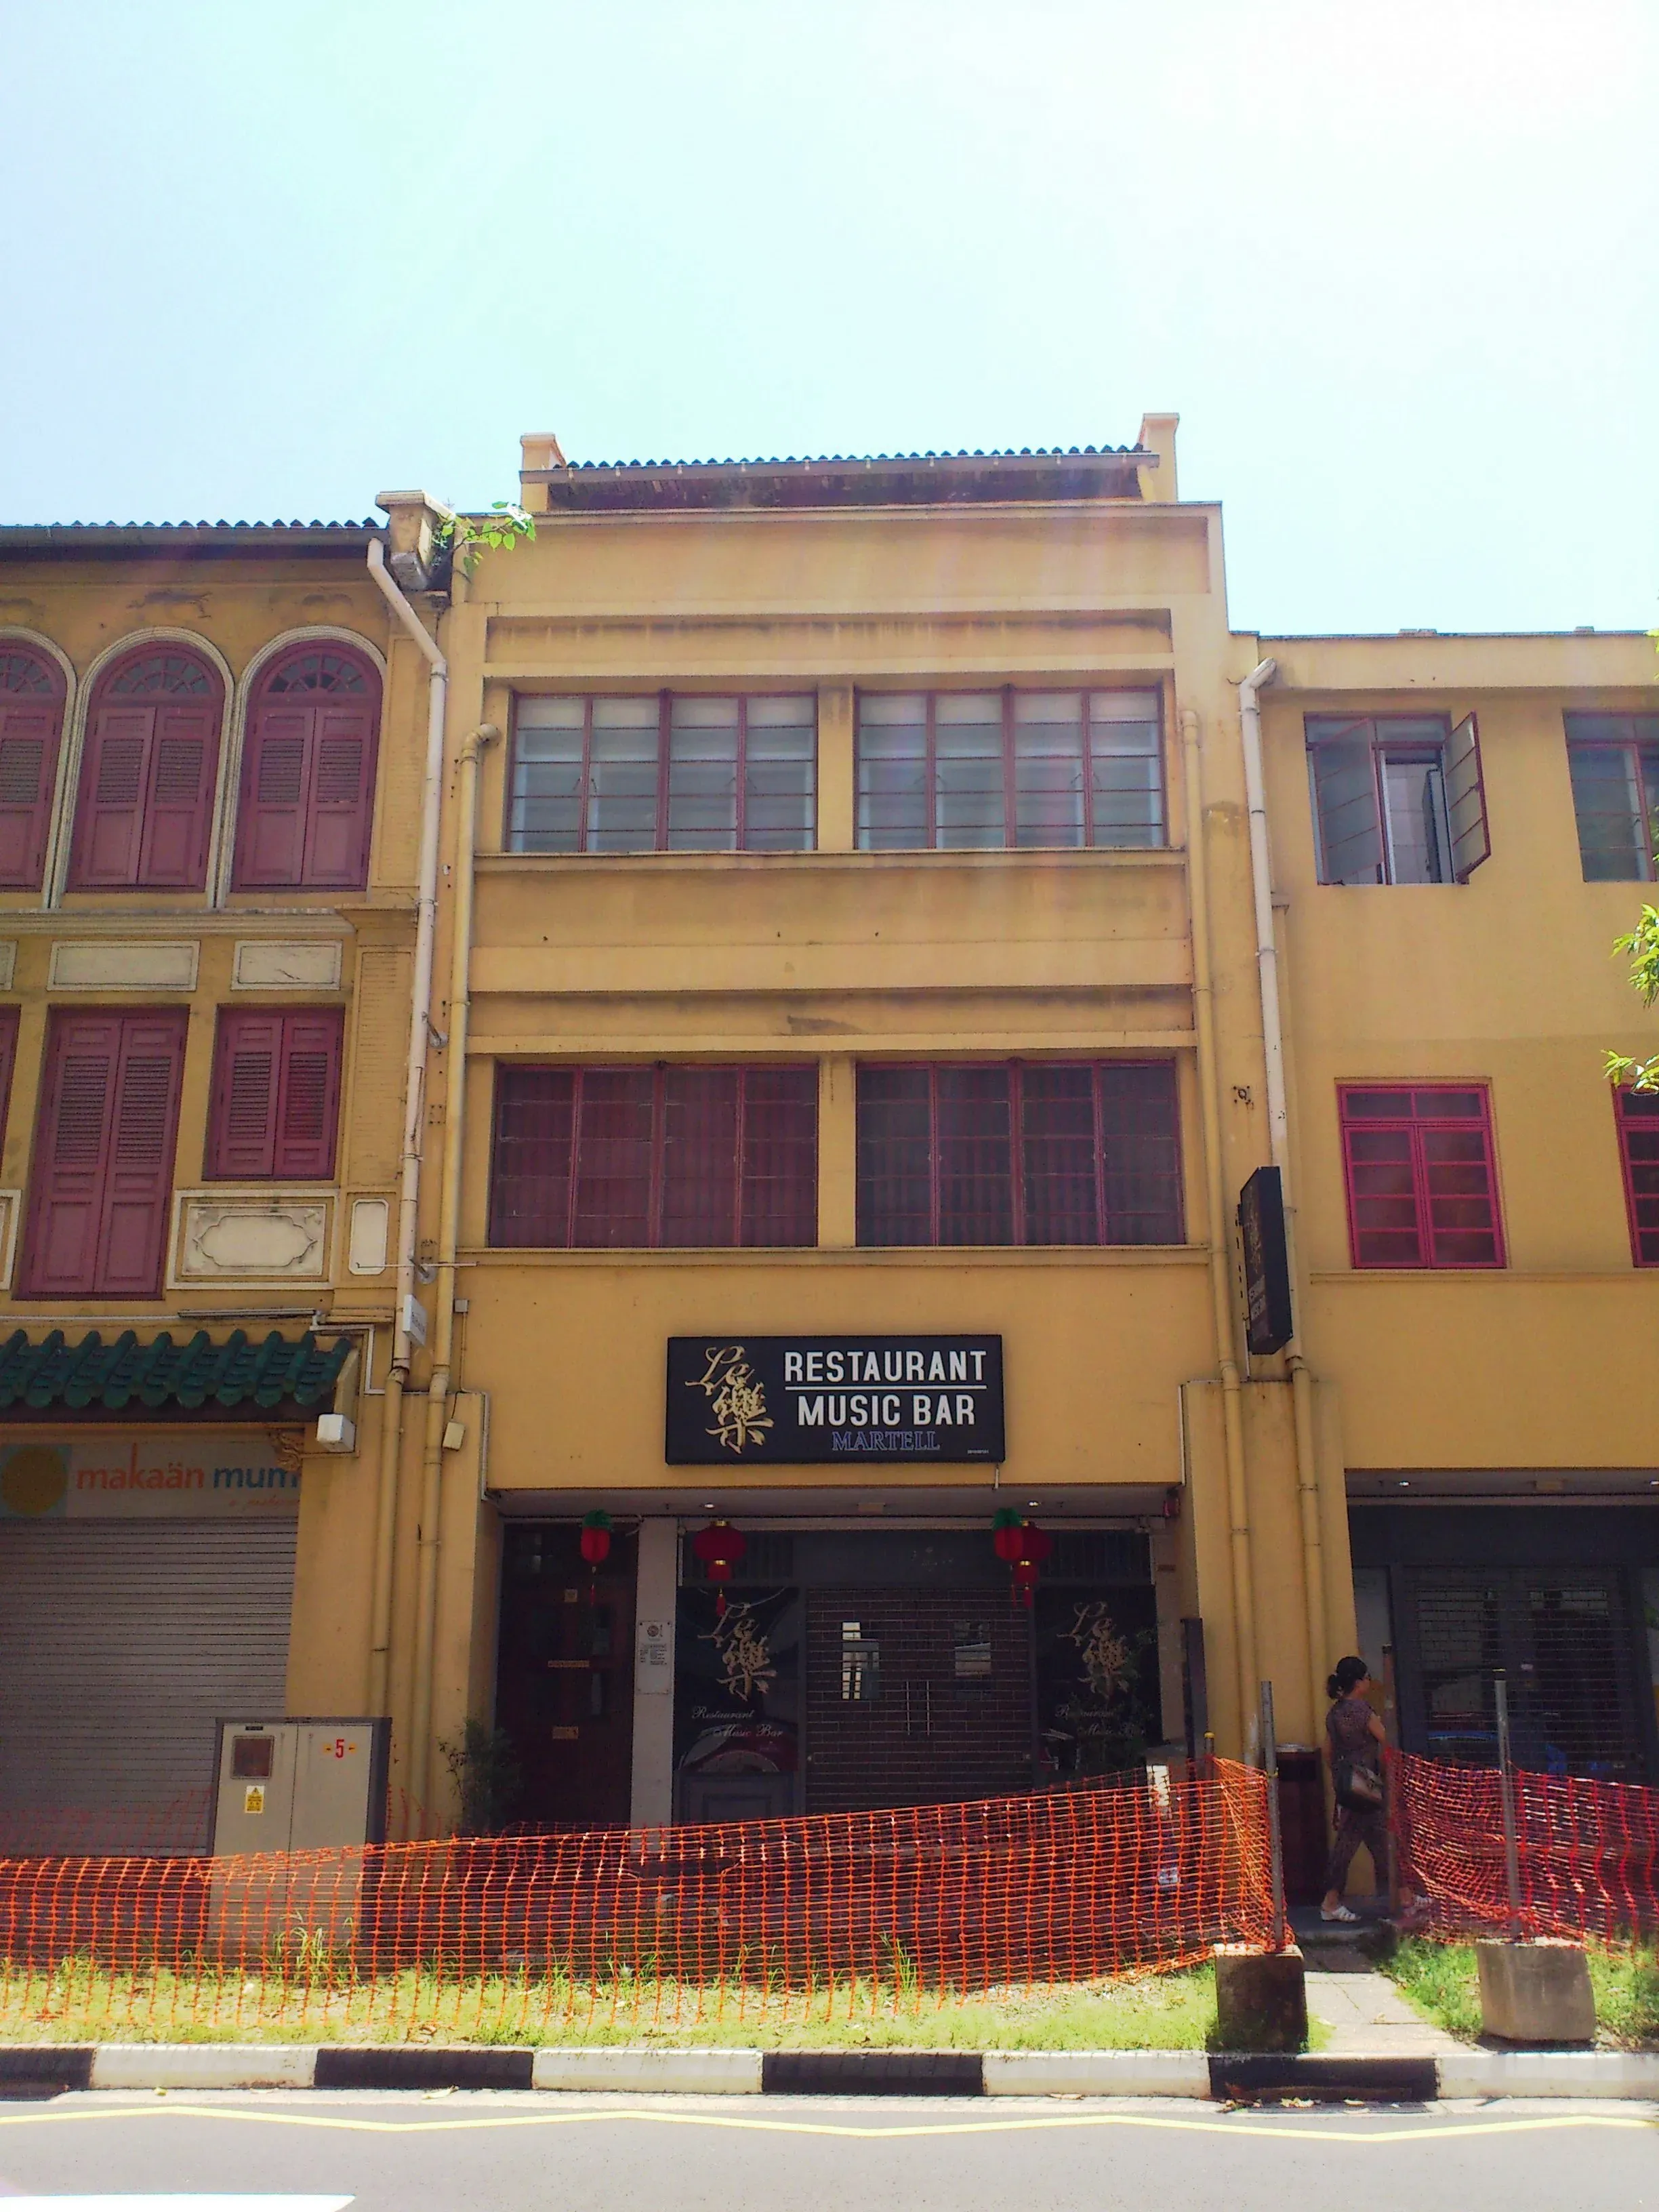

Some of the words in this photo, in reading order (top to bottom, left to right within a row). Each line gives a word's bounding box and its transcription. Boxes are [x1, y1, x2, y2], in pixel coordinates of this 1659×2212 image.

[684, 1345, 755, 1395] Le
[784, 1351, 987, 1382] RESTAURANT
[798, 1395, 900, 1426] MUSIC
[913, 1395, 975, 1425] BAR
[832, 1431, 940, 1451] MARTELL
[76, 1442, 205, 1490] makaän
[691, 1705, 755, 1719] Restaurant
[756, 1723, 783, 1737] Bar
[335, 1739, 344, 1759] 5
